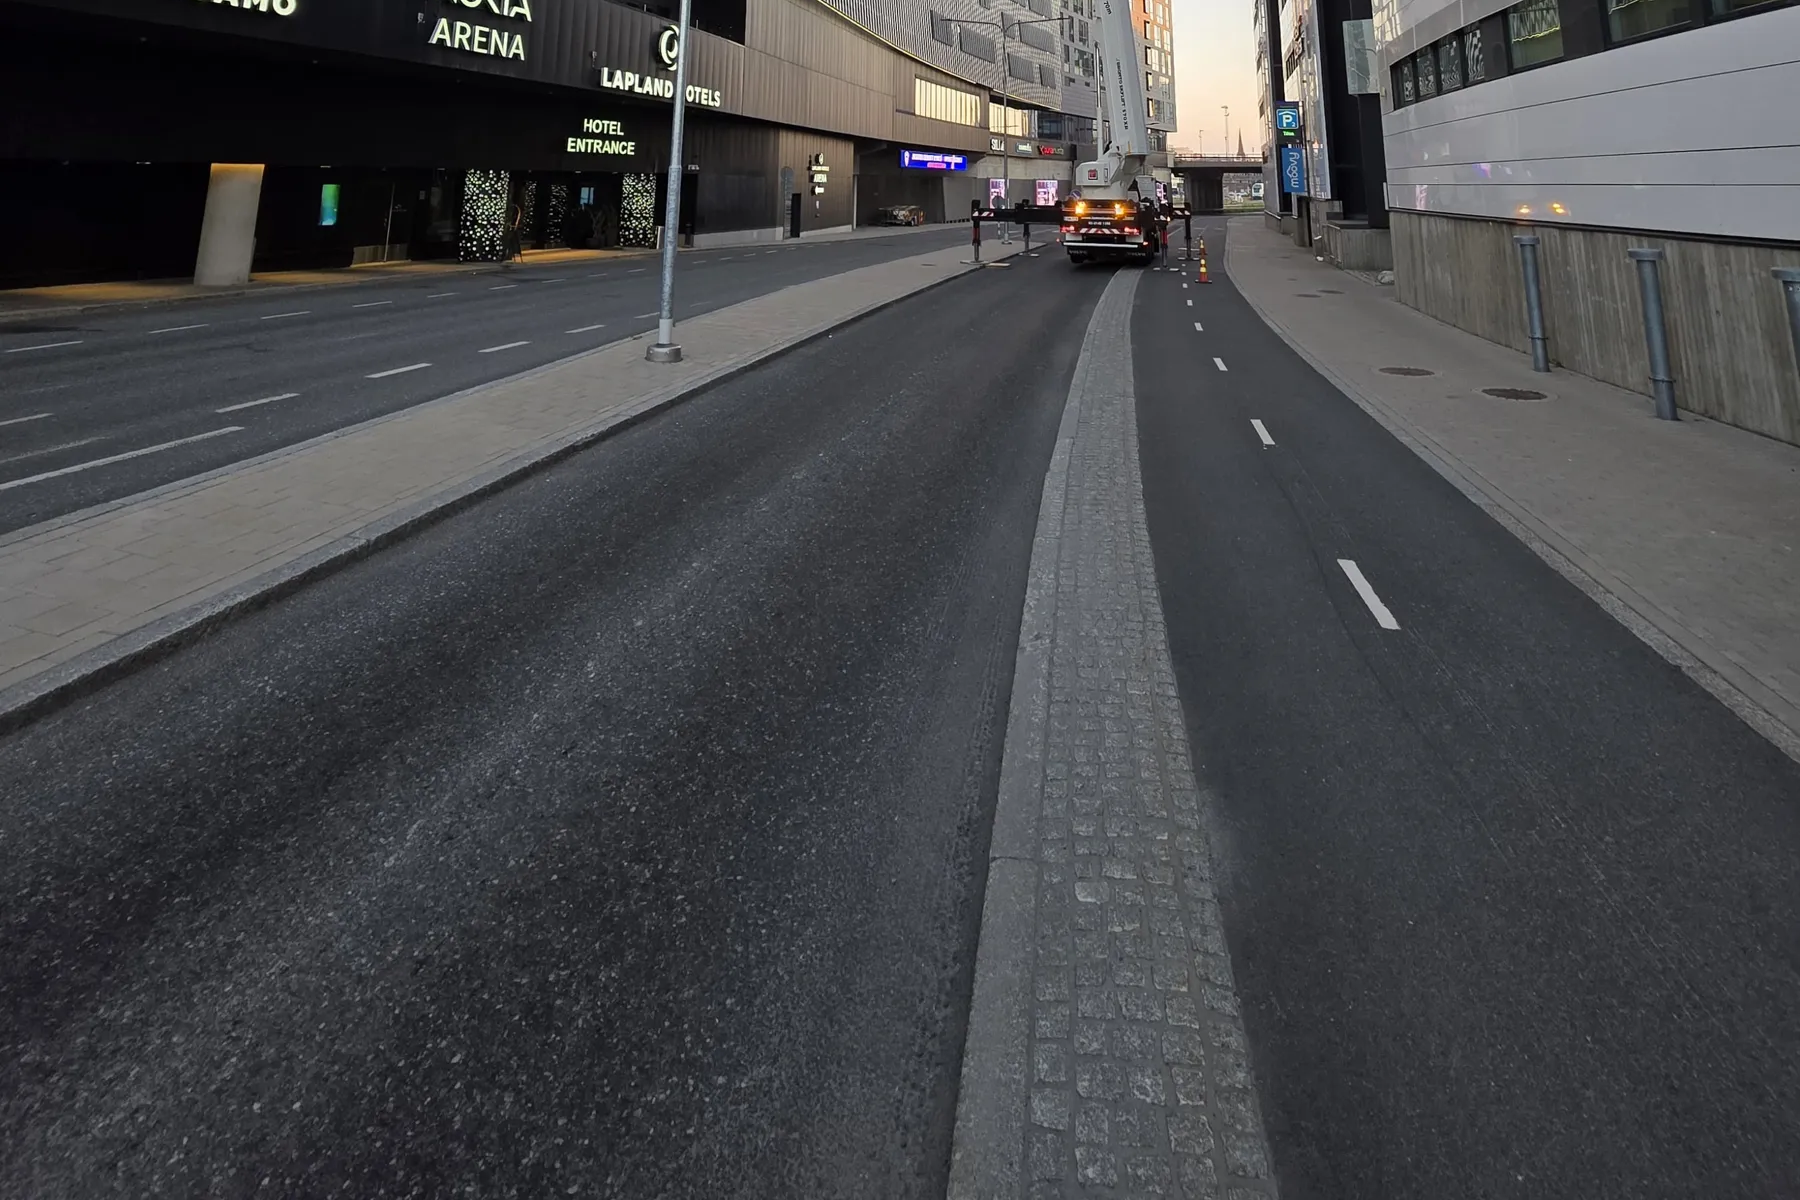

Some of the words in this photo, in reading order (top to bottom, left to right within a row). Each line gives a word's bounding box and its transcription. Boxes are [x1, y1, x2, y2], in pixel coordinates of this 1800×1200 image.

[428, 18, 525, 61] ARENA
[601, 67, 674, 99] LAPLAND
[685, 85, 721, 107] OTELS
[583, 118, 625, 136] HOTEL
[567, 137, 635, 155] ENTRANCE
[1289, 152, 1300, 188] moovy
